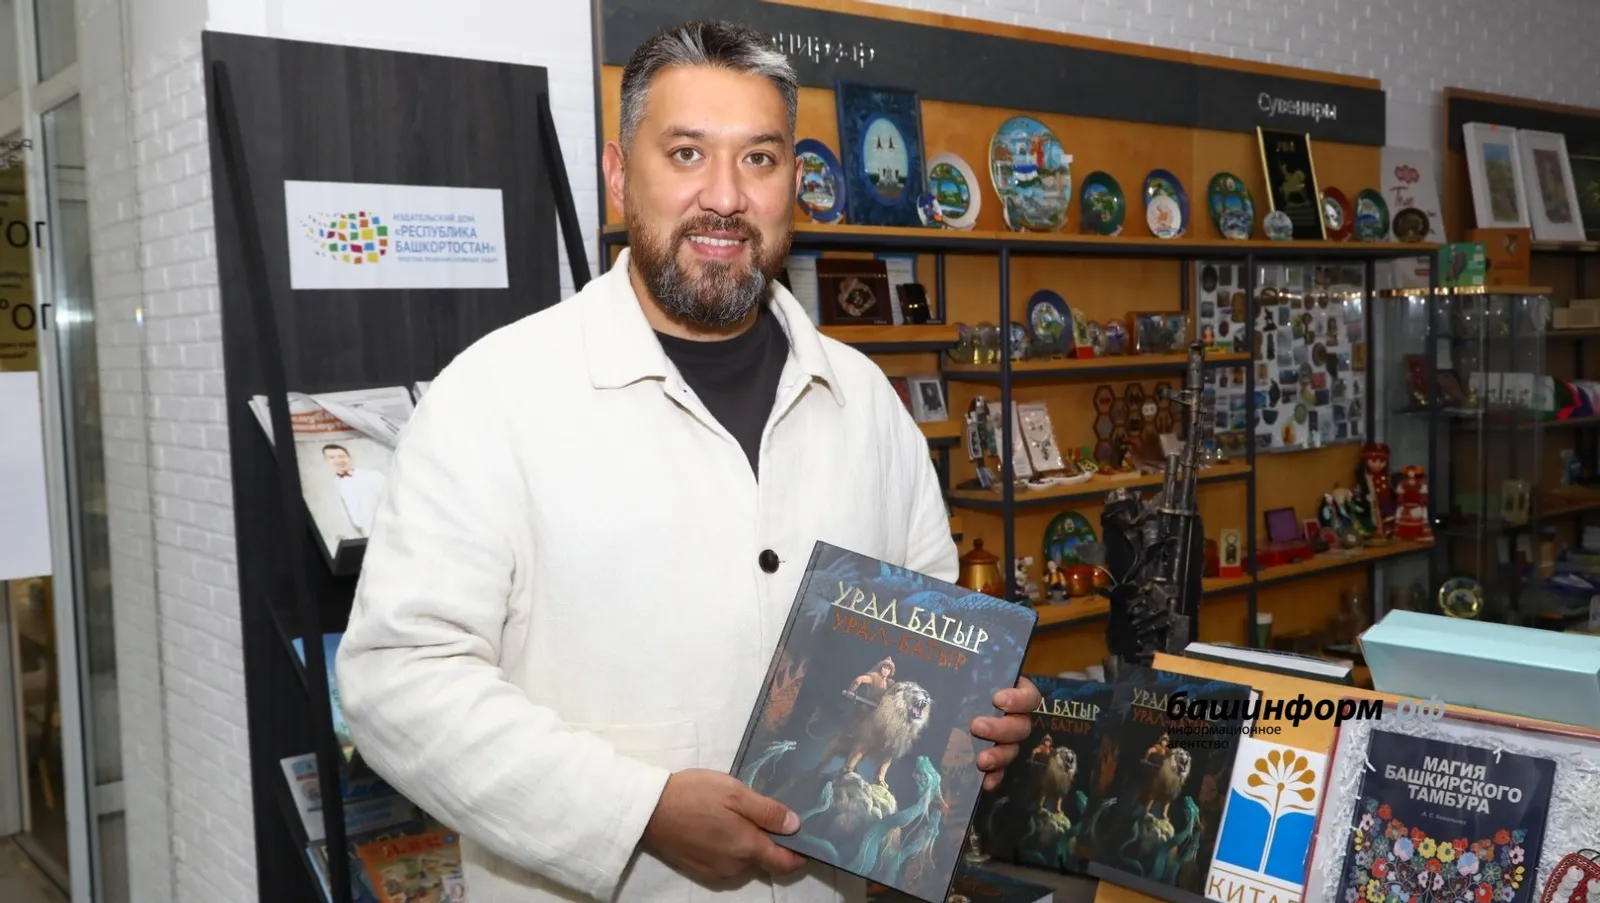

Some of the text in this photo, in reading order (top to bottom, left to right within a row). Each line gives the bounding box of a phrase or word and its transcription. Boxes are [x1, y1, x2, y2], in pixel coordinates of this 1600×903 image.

[1258, 92, 1337, 122] Сувениры
[395, 225, 477, 239] «РЕСПУБЛИКА
[395, 241, 496, 254] БАШКОРТОСТАН»
[831, 581, 989, 653] УРАЛ БАТЫР
[833, 613, 967, 670] УРАЛ-БАТЫР
[1053, 699, 1100, 721] БАТЫР
[1423, 756, 1487, 781] МАГИЯ
[1384, 764, 1523, 804] БАШКИРСКОГО
[1408, 784, 1490, 815] ТАМБУРА
[1208, 875, 1299, 903] КИТА
